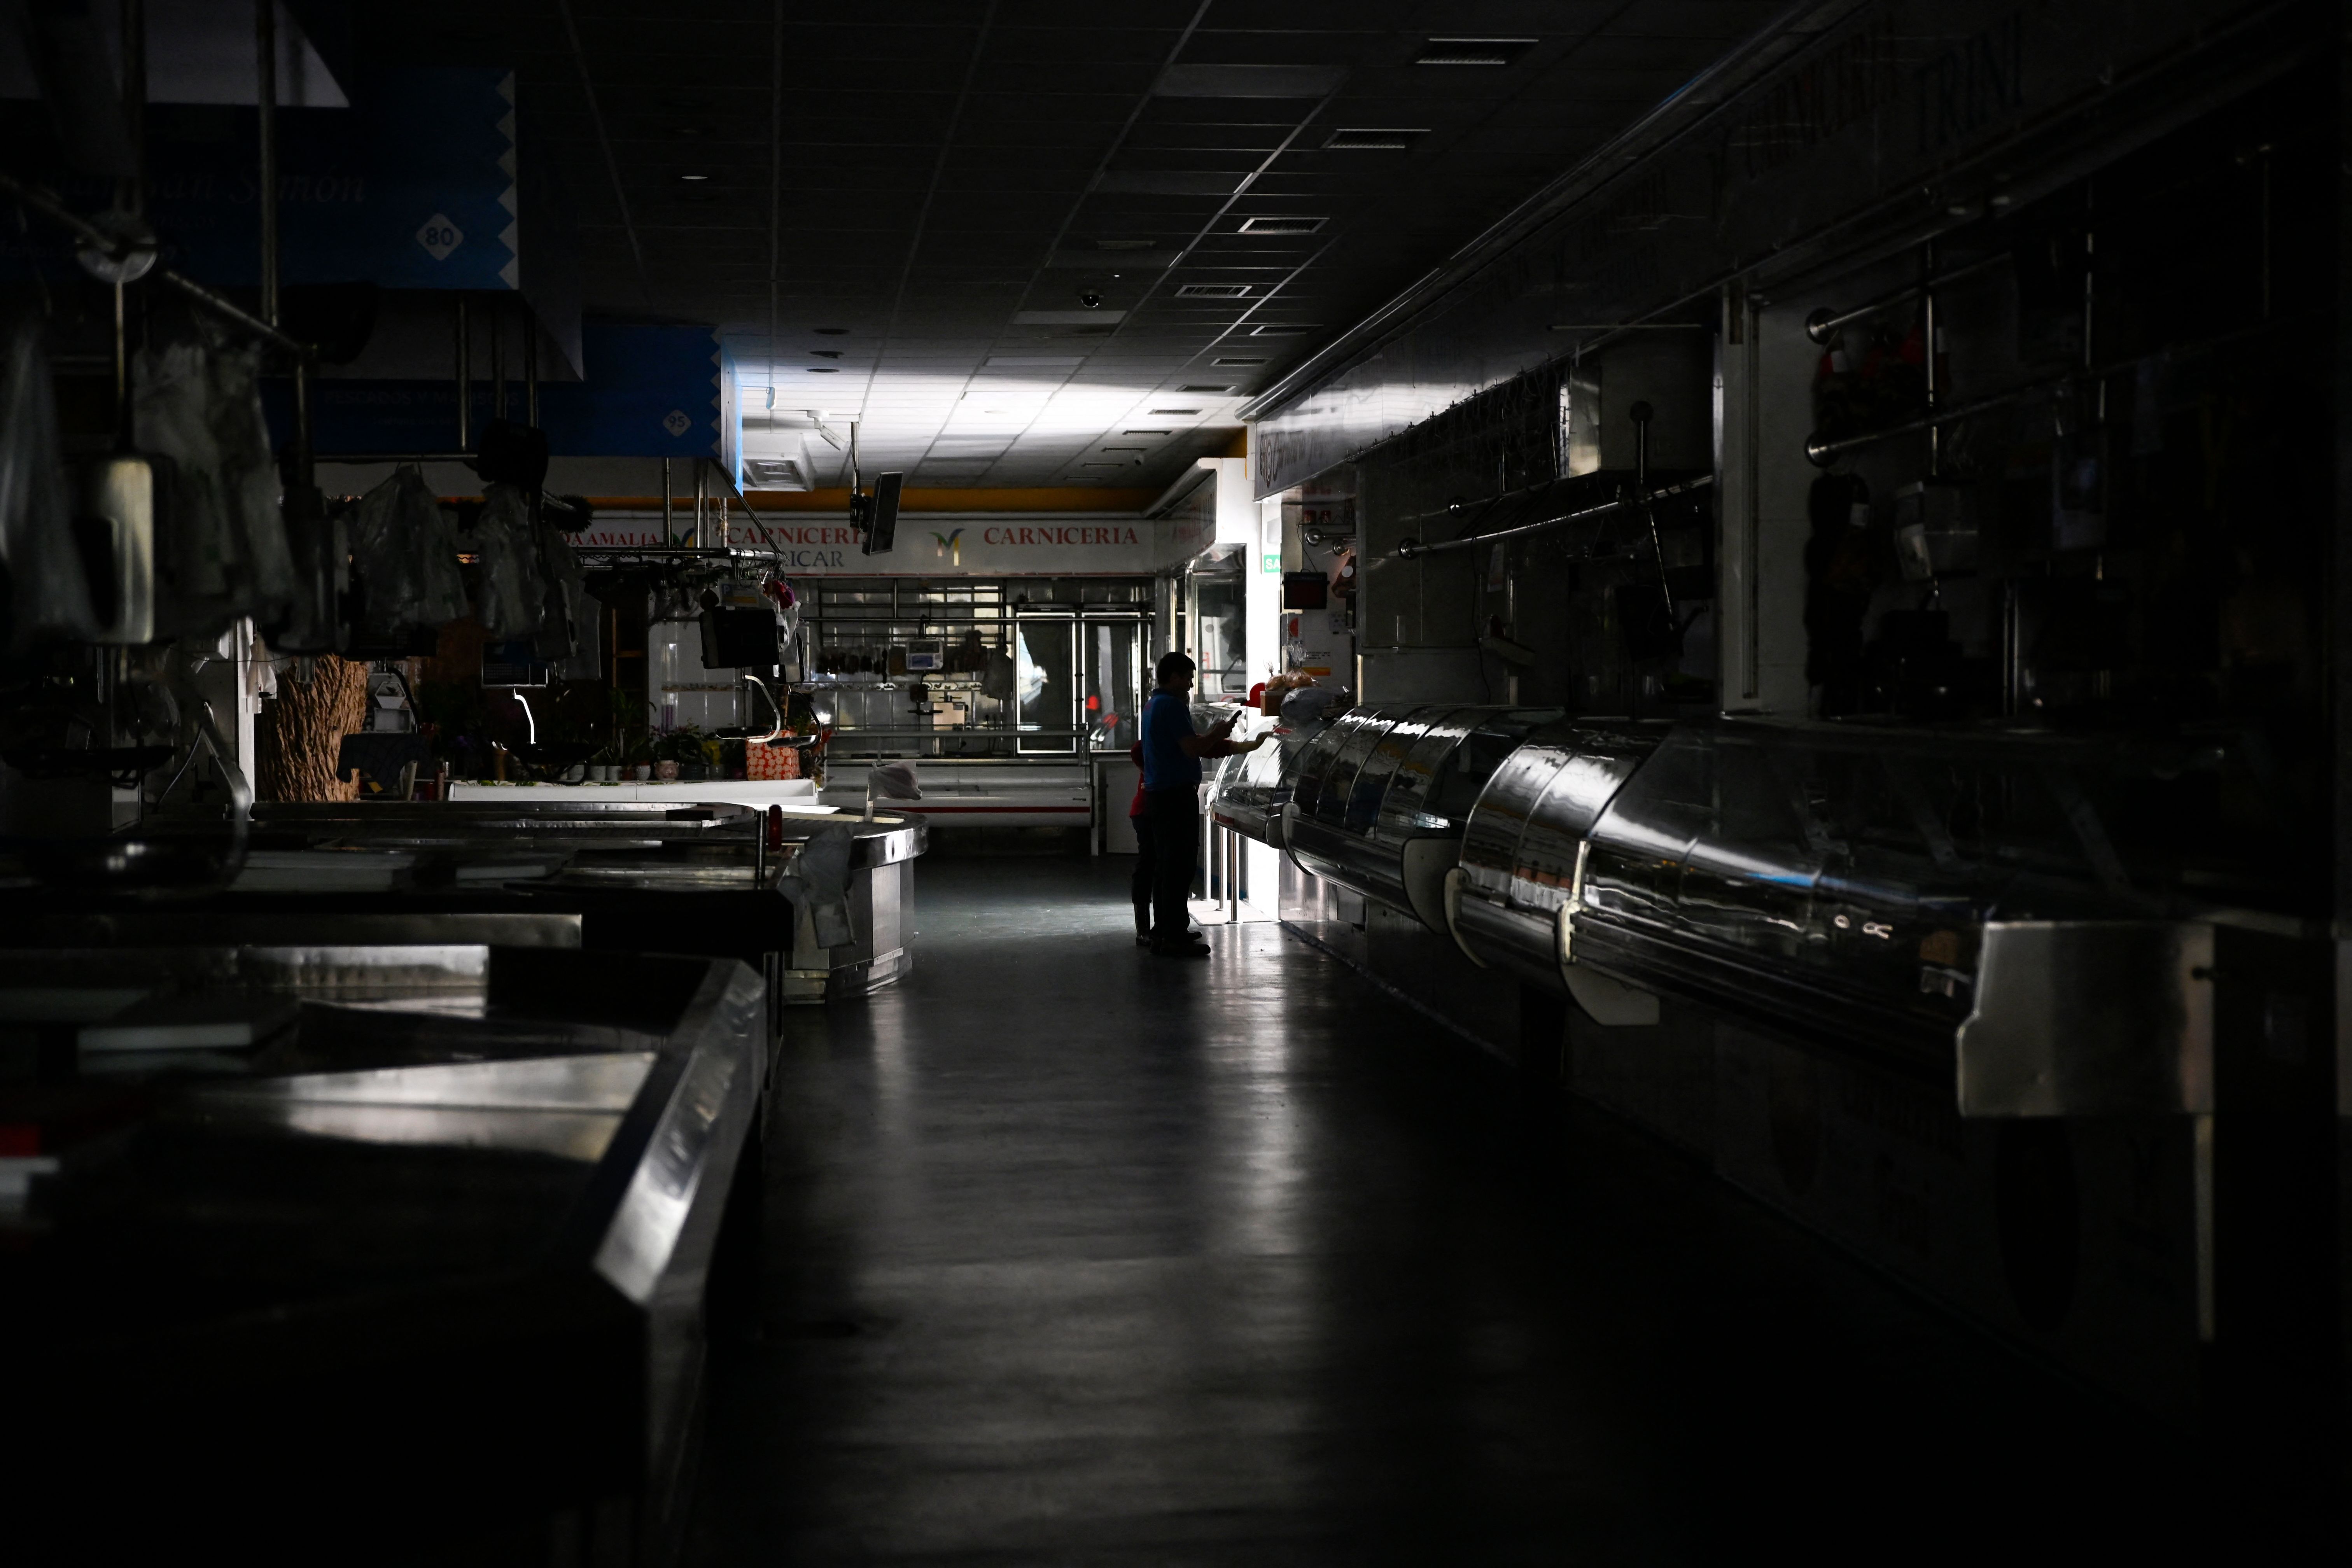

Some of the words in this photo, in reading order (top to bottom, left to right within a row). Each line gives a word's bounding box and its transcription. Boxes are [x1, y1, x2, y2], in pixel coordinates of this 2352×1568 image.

[1914, 12, 2022, 154] TRINI
[229, 162, 366, 205] Smón
[425, 227, 454, 246] 80
[668, 415, 686, 428] 95
[587, 532, 658, 545] AMALIA
[727, 527, 870, 544] CARNICERI
[984, 527, 1139, 544] CARNICERIA
